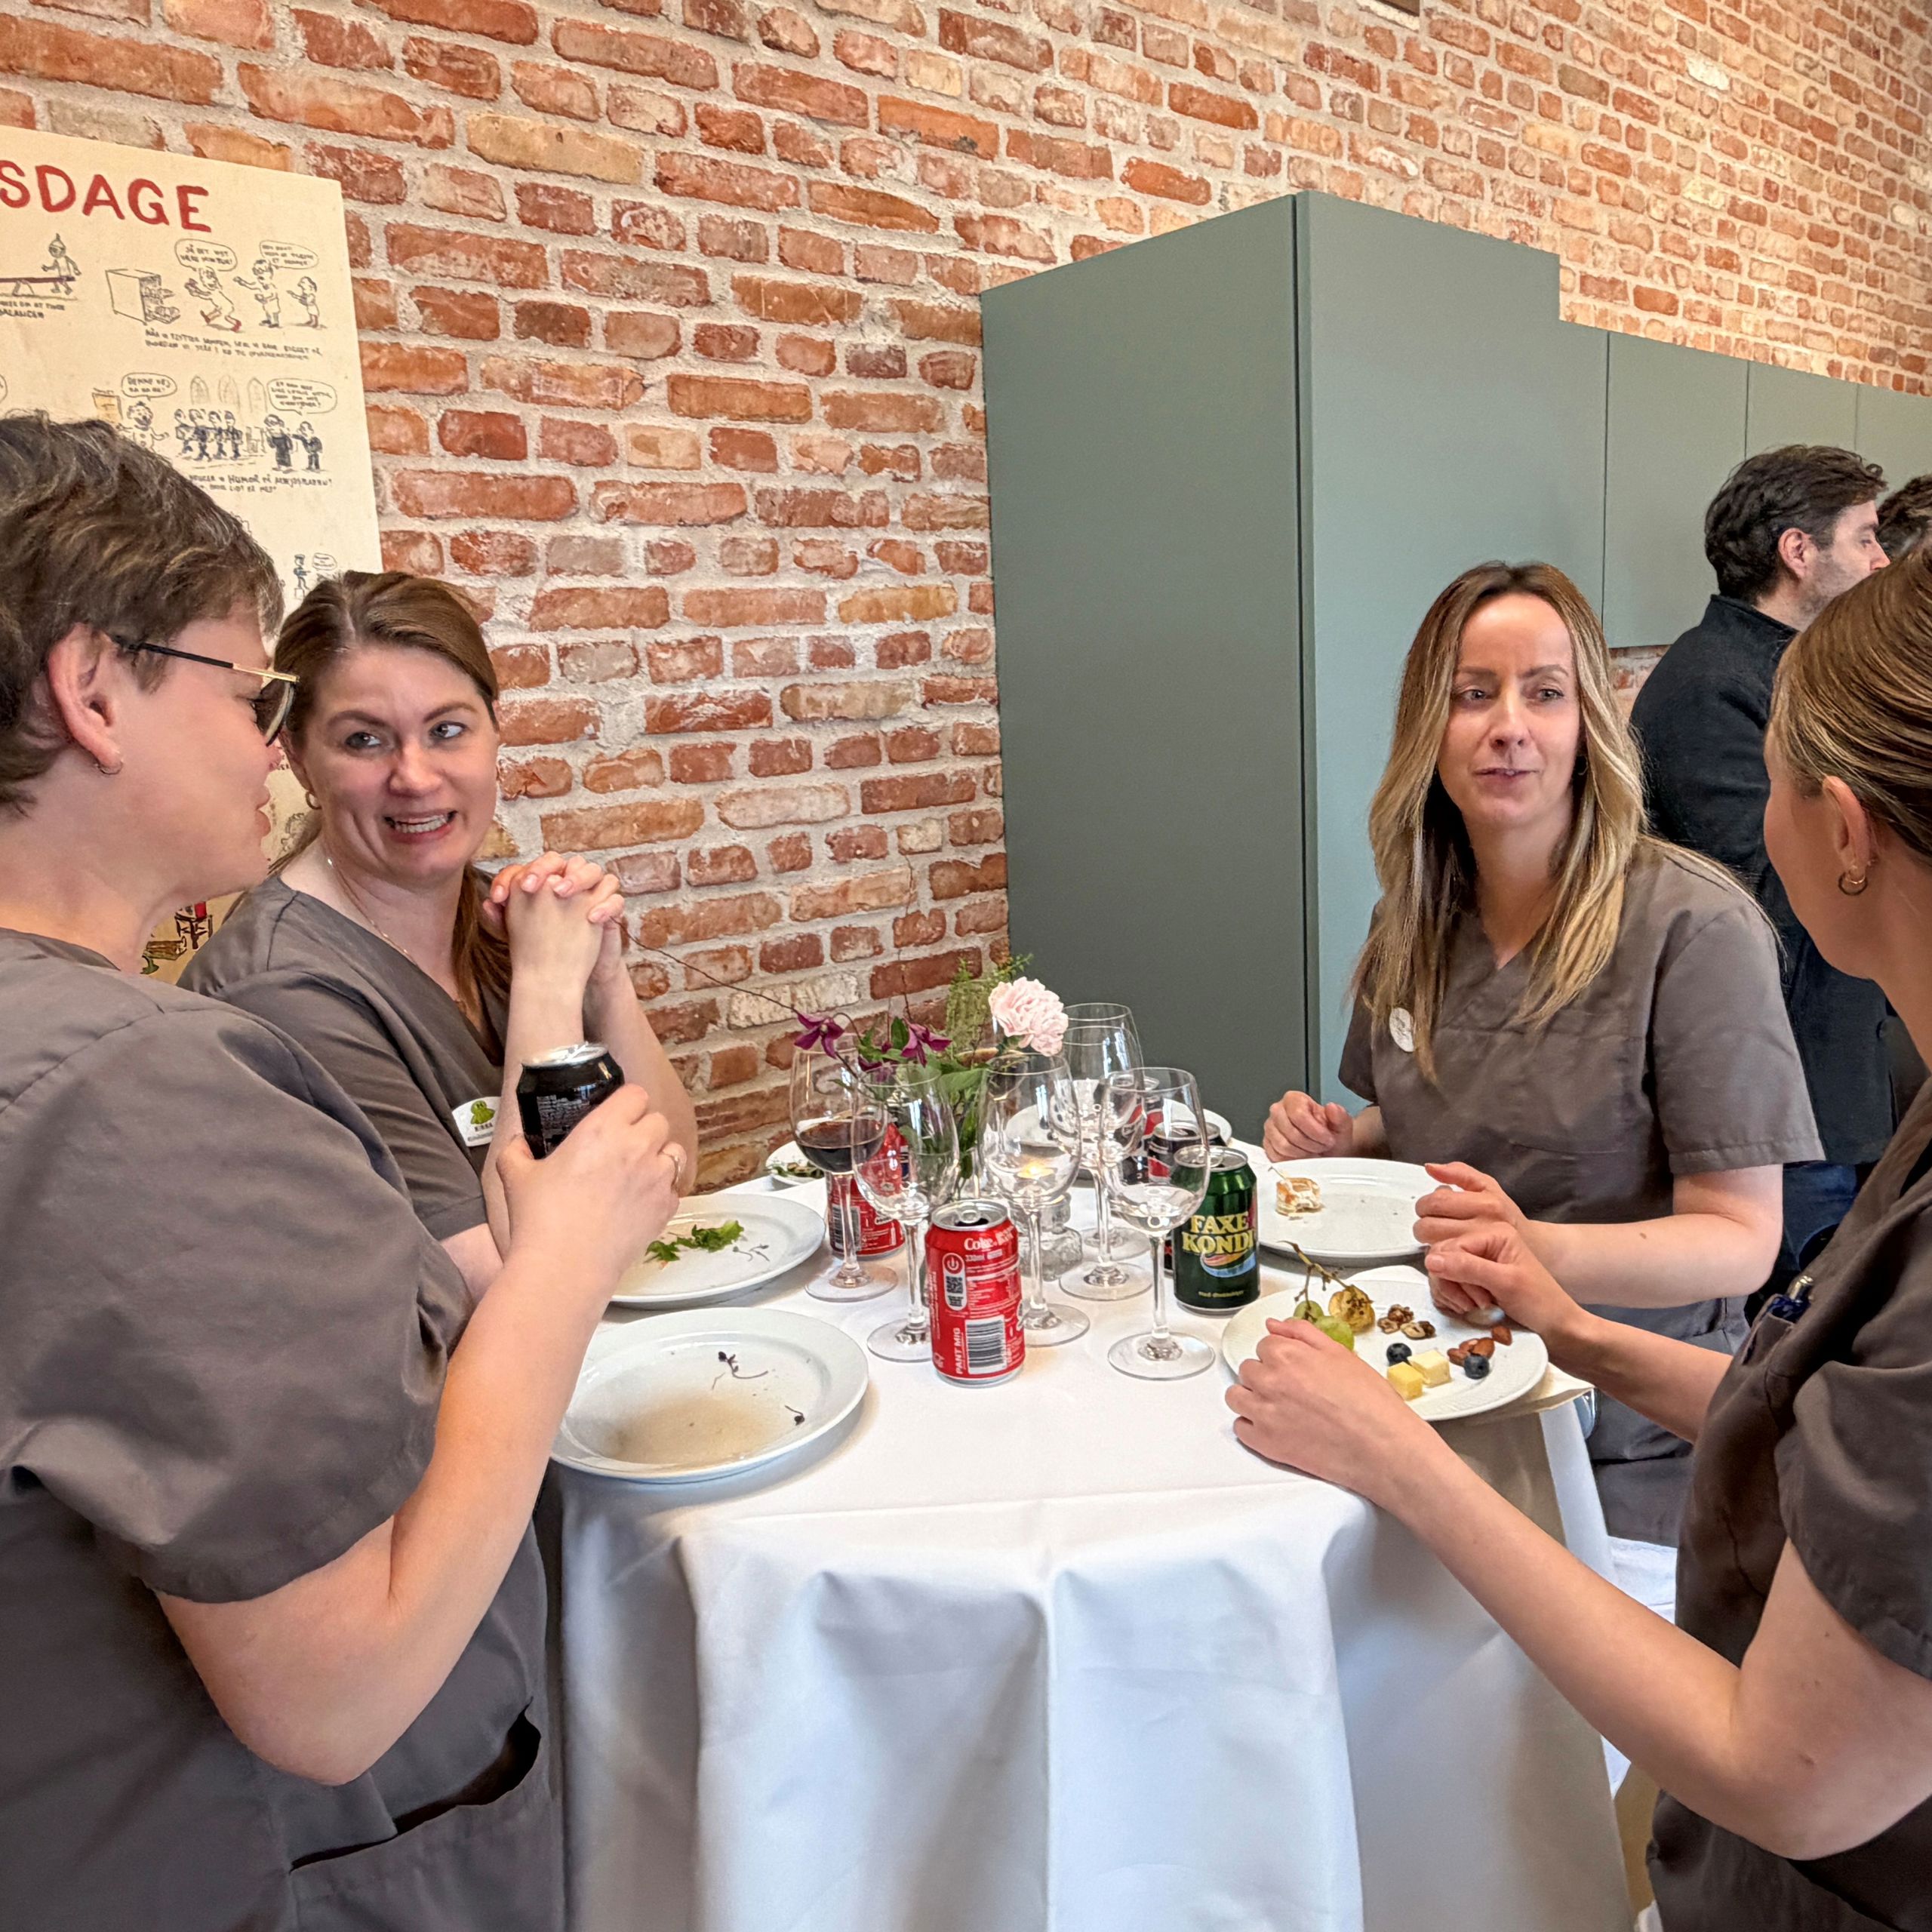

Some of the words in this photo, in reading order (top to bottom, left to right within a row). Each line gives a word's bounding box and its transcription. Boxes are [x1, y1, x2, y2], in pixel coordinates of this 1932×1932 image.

[0, 160, 212, 232] SDAGE
[1190, 1211, 1249, 1235] FAXE
[964, 1235, 994, 1251] Coke
[1181, 1230, 1255, 1255] KONDI
[953, 1327, 961, 1346] MIG
[954, 1349, 964, 1374] PANT
